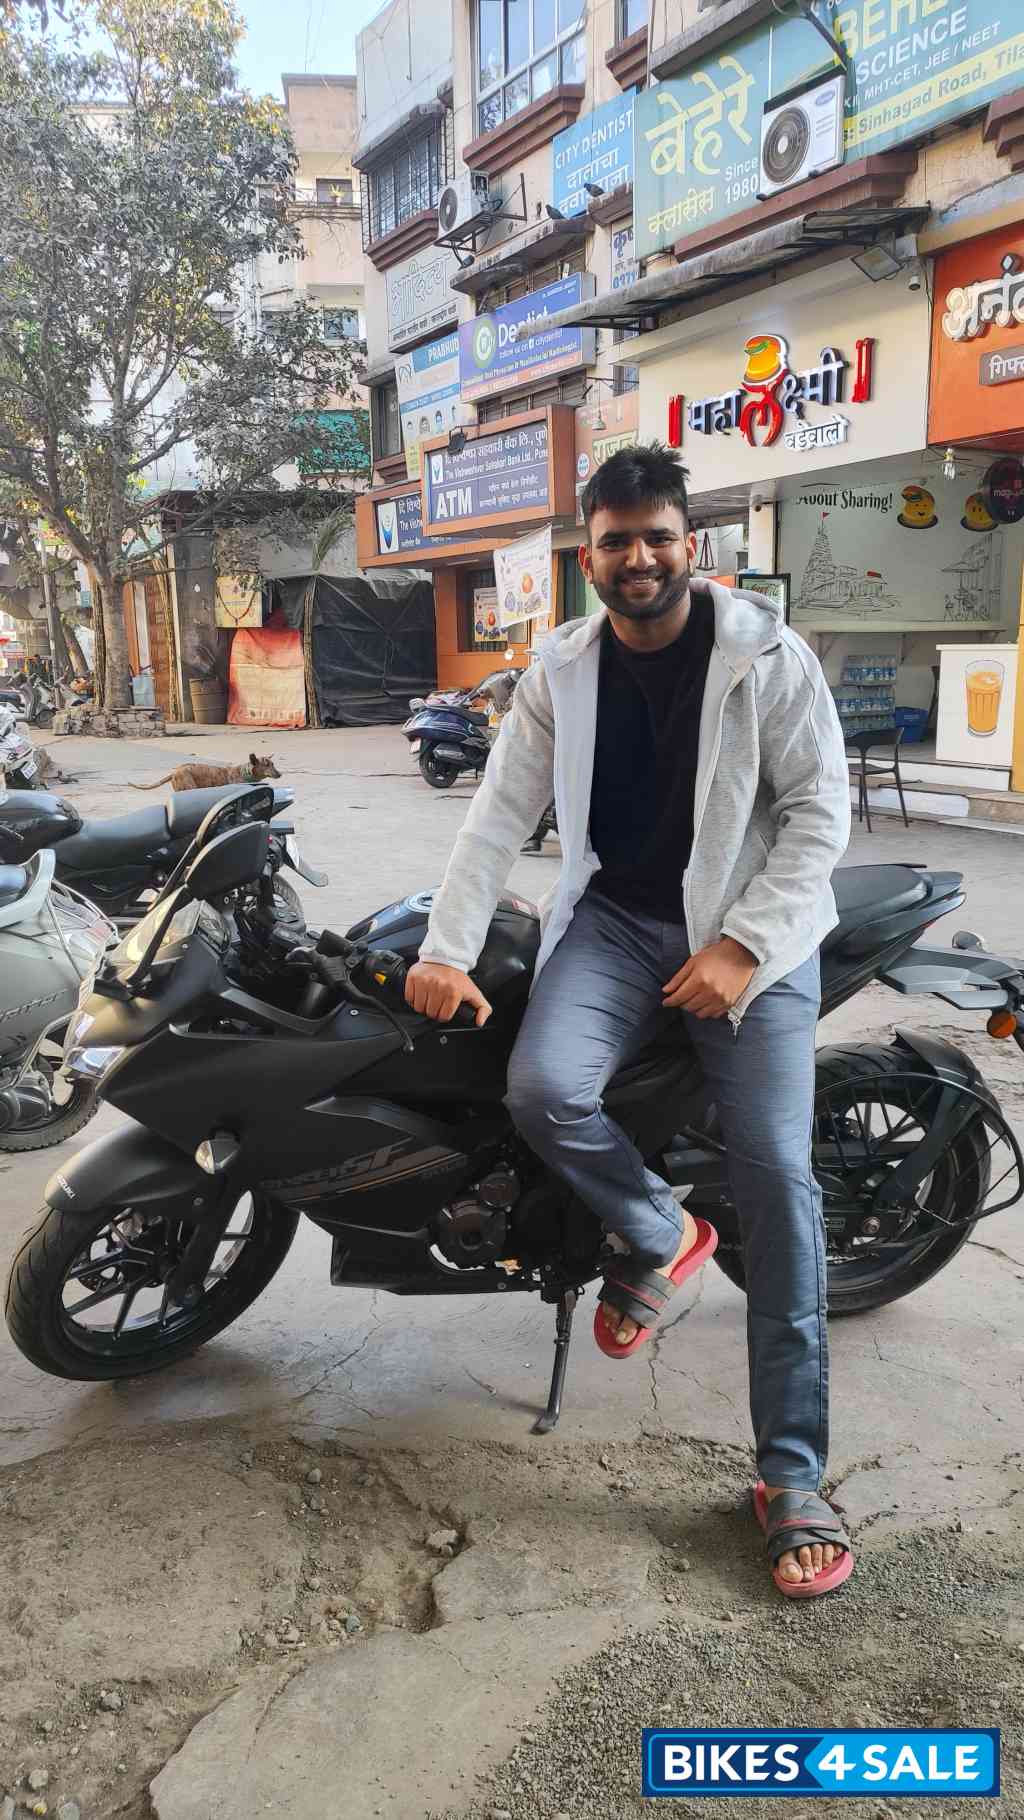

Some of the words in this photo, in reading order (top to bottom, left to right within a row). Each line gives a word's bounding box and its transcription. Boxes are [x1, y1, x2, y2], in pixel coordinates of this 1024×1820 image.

[856, 6, 968, 84] SCIENCE
[925, 47, 950, 71] JEE
[961, 19, 1001, 54] NEET
[644, 56, 756, 176] बेहेरे
[858, 88, 932, 135] Sinhagad
[555, 141, 580, 169] CITY
[582, 109, 633, 154] DENTIST
[724, 173, 760, 205] 1980
[508, 452, 521, 467] Bank
[436, 486, 473, 519] ATM
[841, 489, 893, 514] Sharing!
